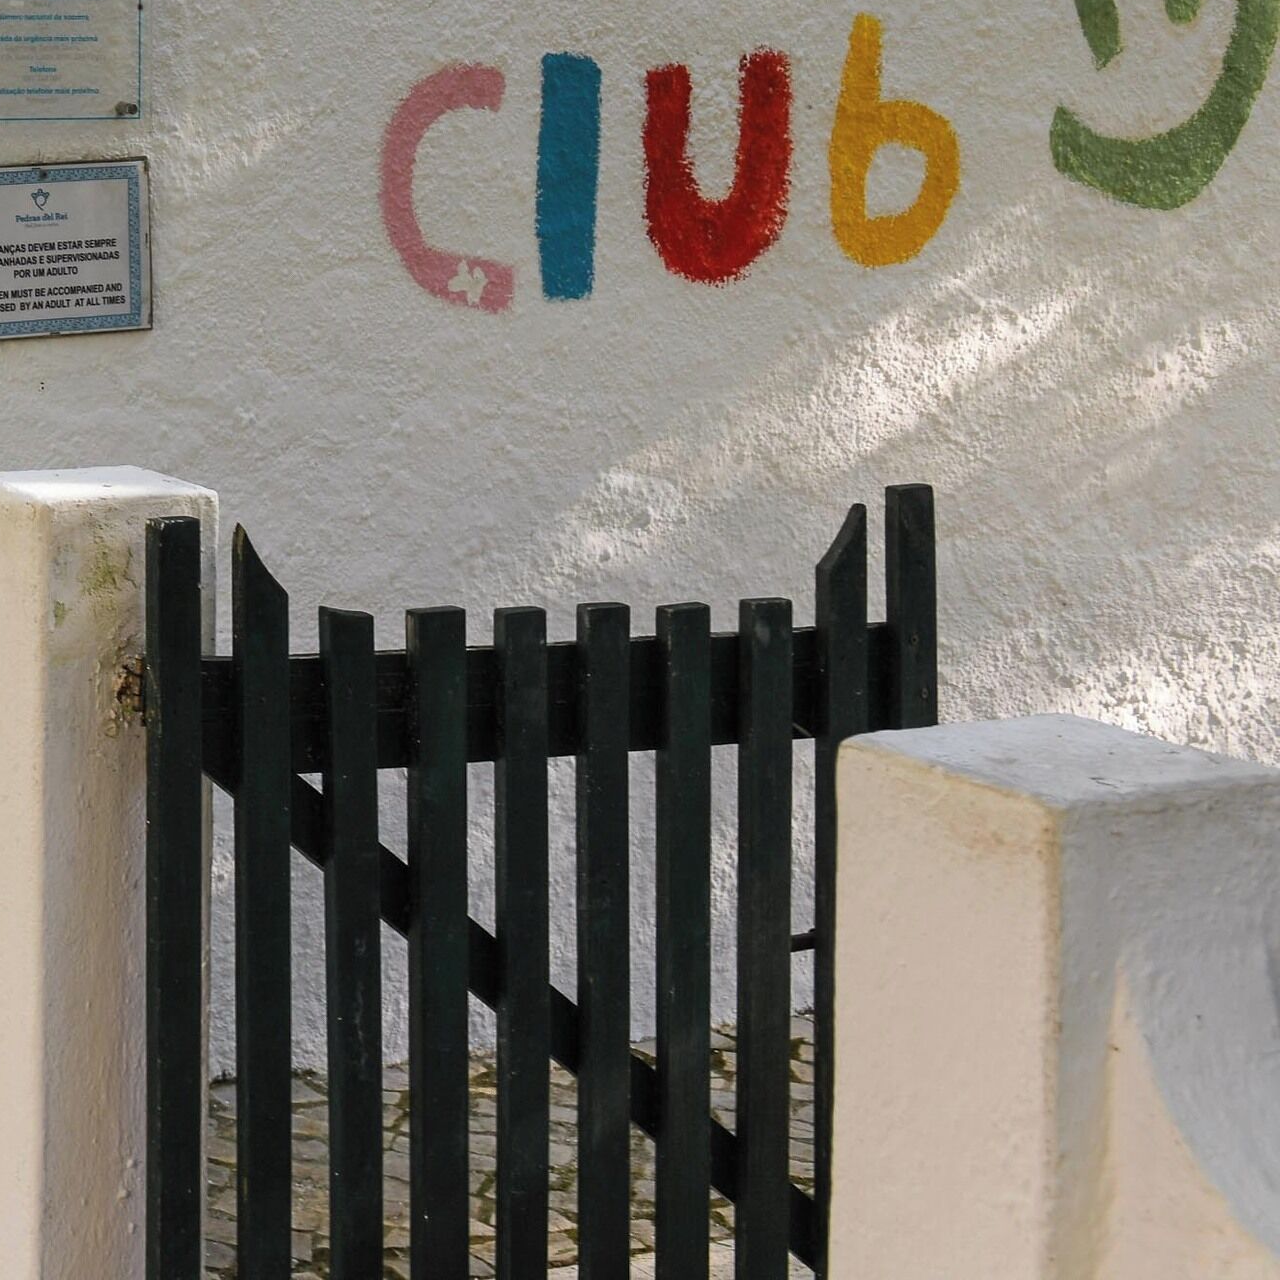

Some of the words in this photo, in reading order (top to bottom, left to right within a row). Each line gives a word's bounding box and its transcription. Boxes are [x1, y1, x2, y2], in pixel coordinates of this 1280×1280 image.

[28, 242, 56, 252] DEVEM
[57, 240, 83, 250] ESTAR
[85, 238, 117, 248] SEMPRE
[39, 255, 45, 265] E
[46, 251, 120, 264] SUPERVISIONADAS
[14, 269, 31, 279] POR
[33, 268, 45, 278] UM
[46, 266, 78, 276] ADULTO
[11, 289, 33, 299] MUST
[34, 288, 45, 297] BE
[47, 284, 104, 296] ACCOMPANIED
[105, 282, 123, 292] AND
[20, 301, 31, 311] BY
[32, 300, 44, 310] AN
[45, 298, 71, 309] ADULT
[74, 298, 86, 308] AT
[86, 296, 100, 306] ALL
[102, 294, 126, 305] TIMES
